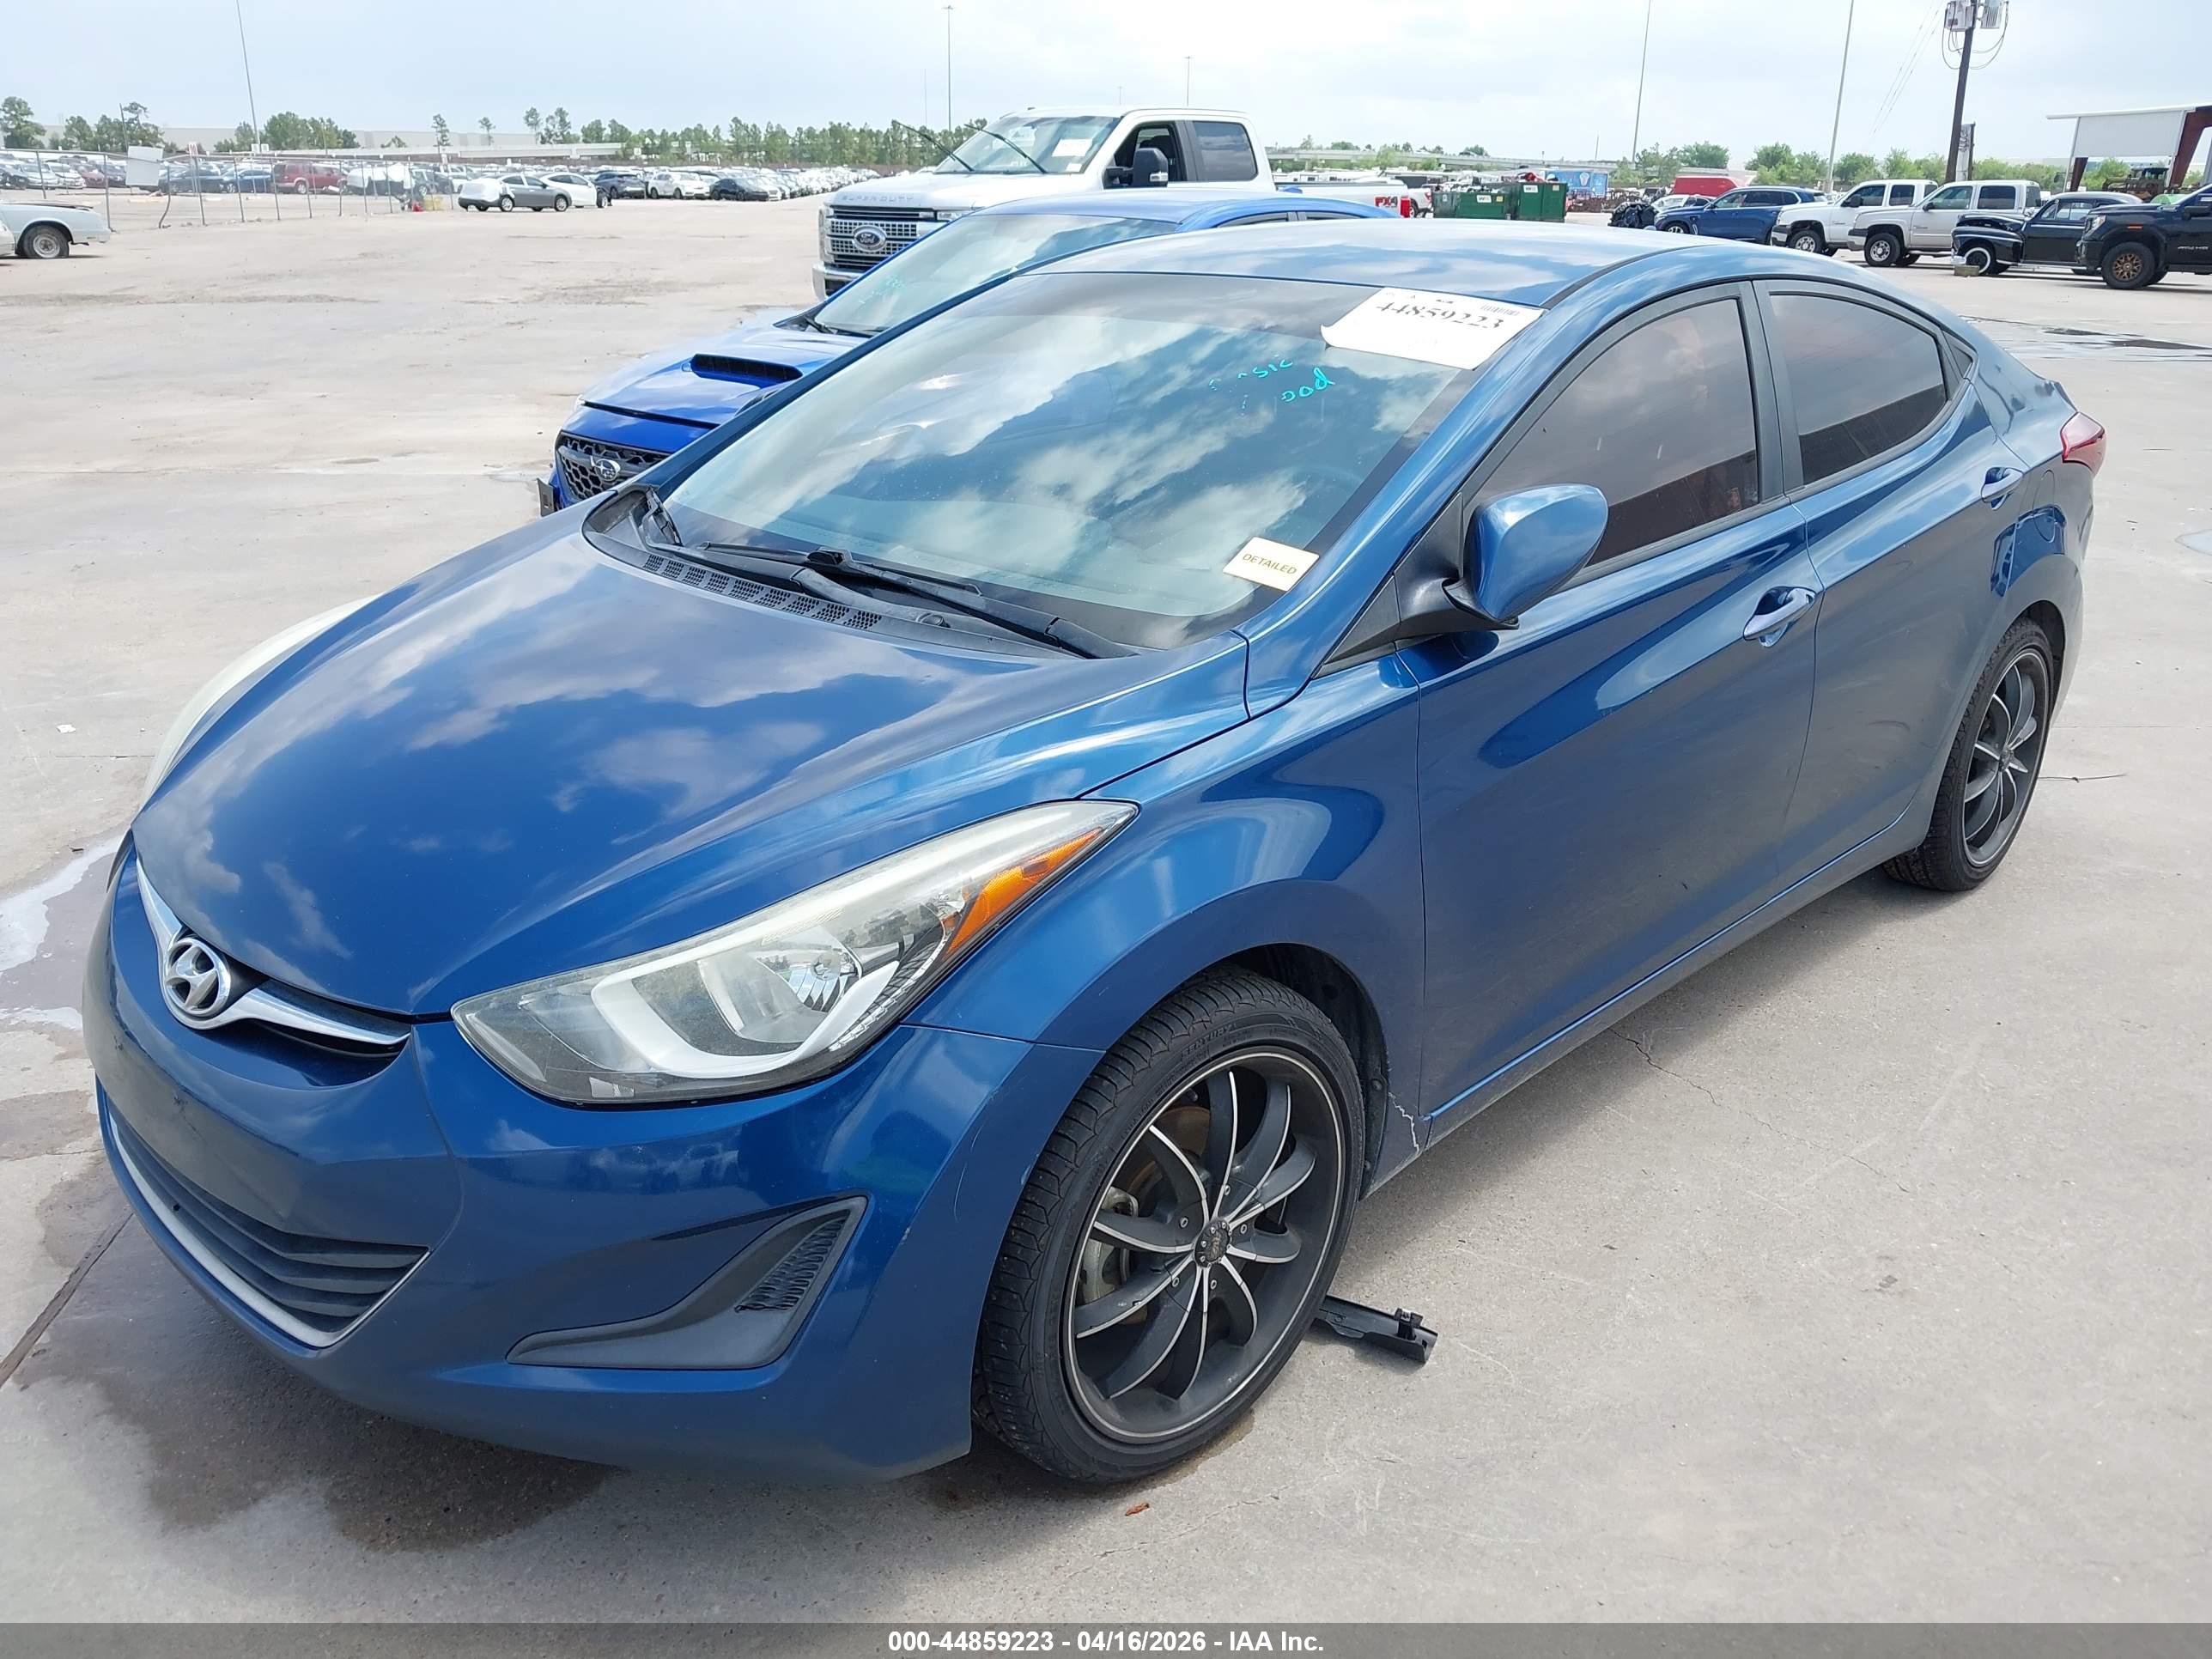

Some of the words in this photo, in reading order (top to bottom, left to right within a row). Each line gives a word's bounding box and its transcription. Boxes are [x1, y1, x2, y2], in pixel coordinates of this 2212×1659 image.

[1375, 197, 1398, 207] FX4
[860, 233, 876, 243] Ford
[1376, 301, 1504, 329] 44859223
[1242, 553, 1297, 575] DETAILED
